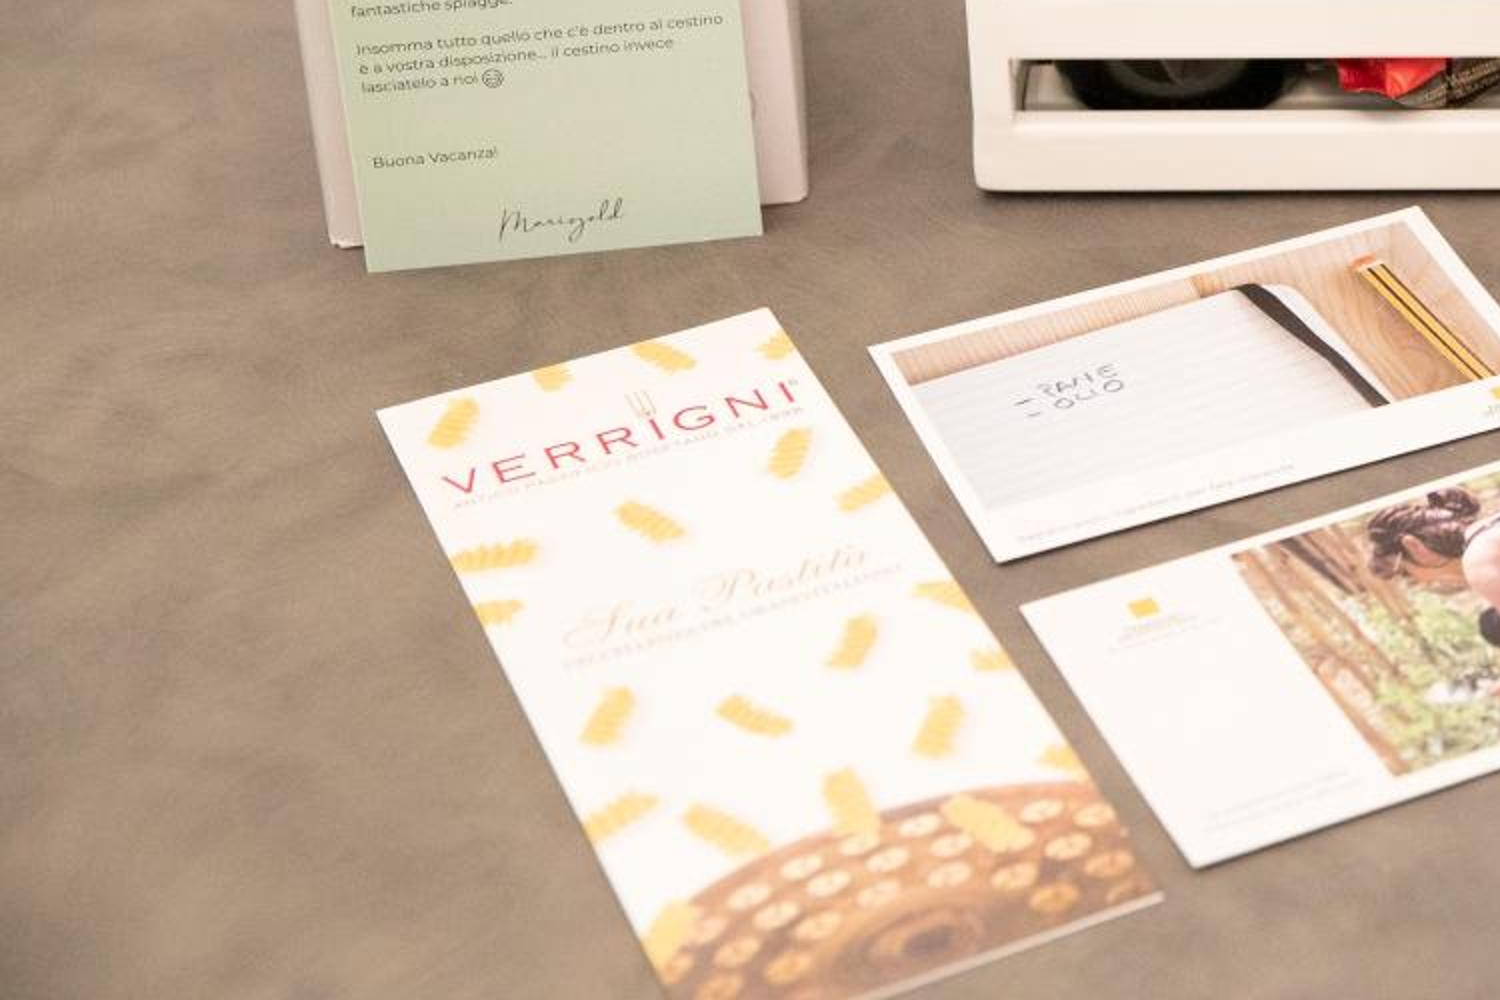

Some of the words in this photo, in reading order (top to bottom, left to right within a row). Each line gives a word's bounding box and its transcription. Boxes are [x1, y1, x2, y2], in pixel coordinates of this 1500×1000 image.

[351, 1, 441, 18] fantastiche
[357, 39, 433, 55] Insomma
[437, 35, 477, 49] tutto
[481, 30, 531, 47] quello
[535, 28, 564, 40] che
[593, 20, 645, 35] dentro
[649, 19, 663, 31] al
[667, 15, 723, 29] cestino
[374, 64, 383, 73] a
[387, 58, 435, 72] vostra
[552, 47, 560, 57] il
[564, 41, 620, 56] cestino
[623, 38, 673, 50] invece
[362, 76, 435, 93] lasciatelo
[440, 78, 449, 87] a
[453, 73, 479, 86] noi
[373, 153, 425, 168] Buona
[428, 146, 498, 163] Vacanza!
[441, 379, 797, 494] VERRIGNI
